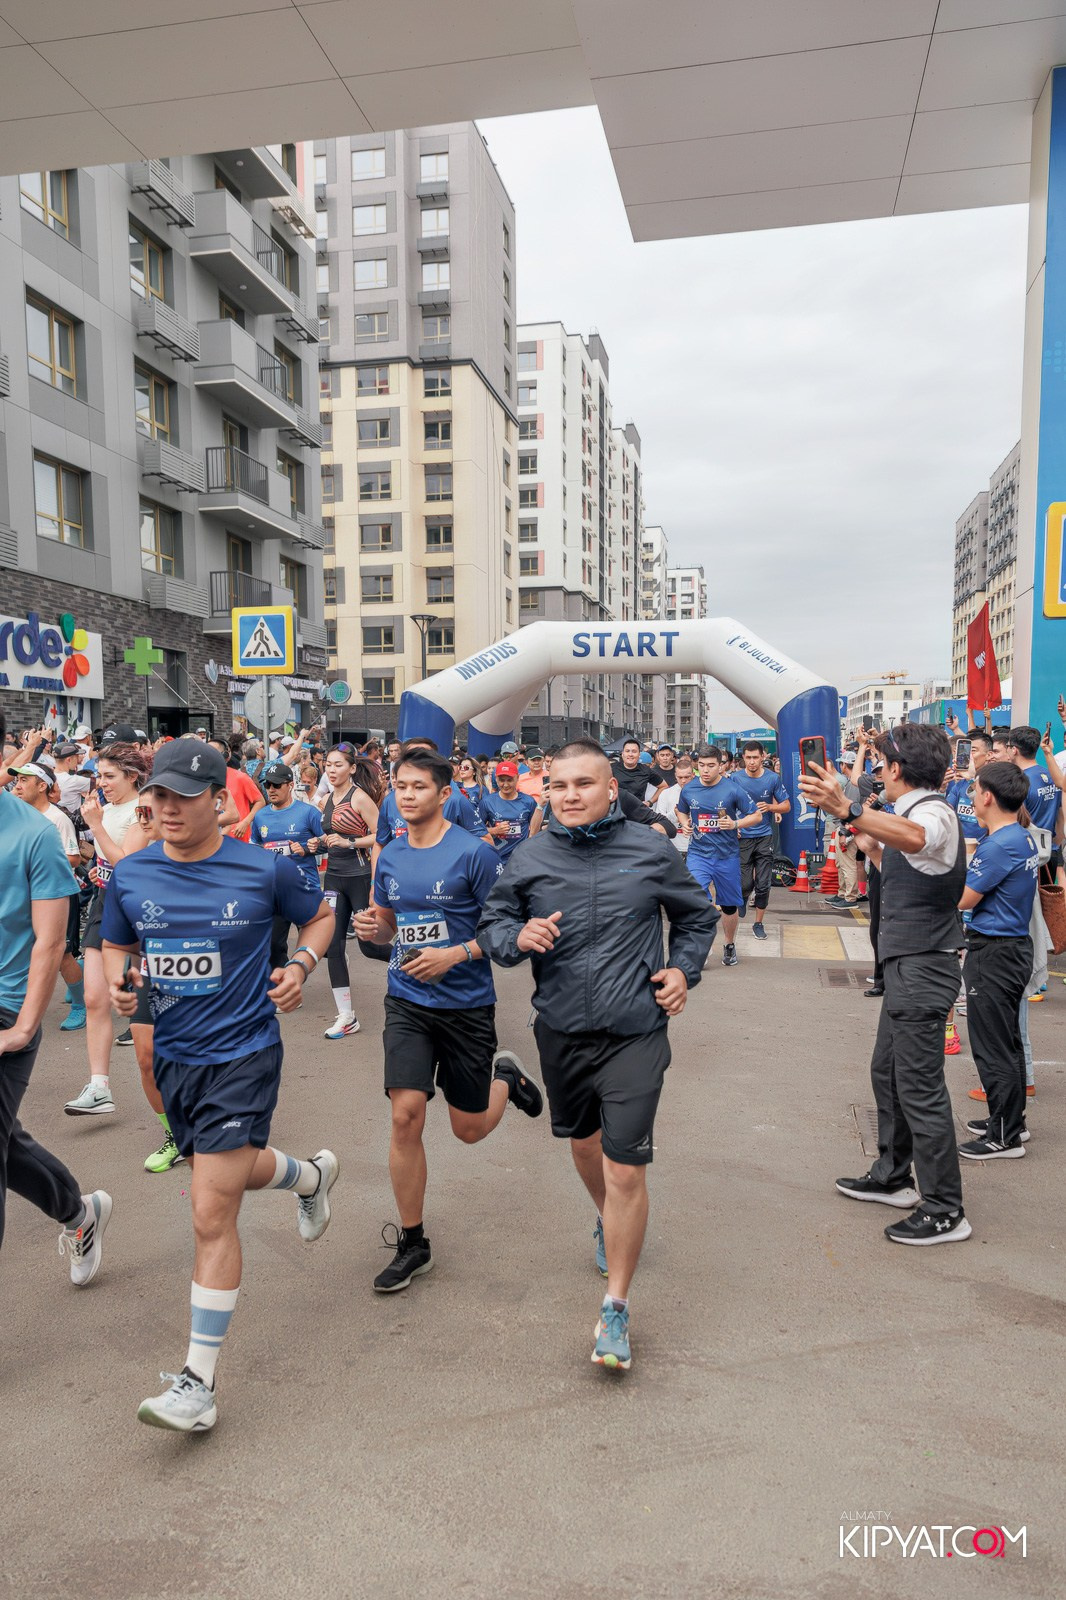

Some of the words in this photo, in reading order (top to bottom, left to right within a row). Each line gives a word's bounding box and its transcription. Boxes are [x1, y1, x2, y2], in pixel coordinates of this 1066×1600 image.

[572, 631, 680, 658] START
[739, 641, 749, 651] BI
[747, 648, 787, 674] JULDYZAI
[454, 642, 518, 681] INVICTUS
[401, 924, 441, 943] 1834
[153, 956, 213, 977] 1200
